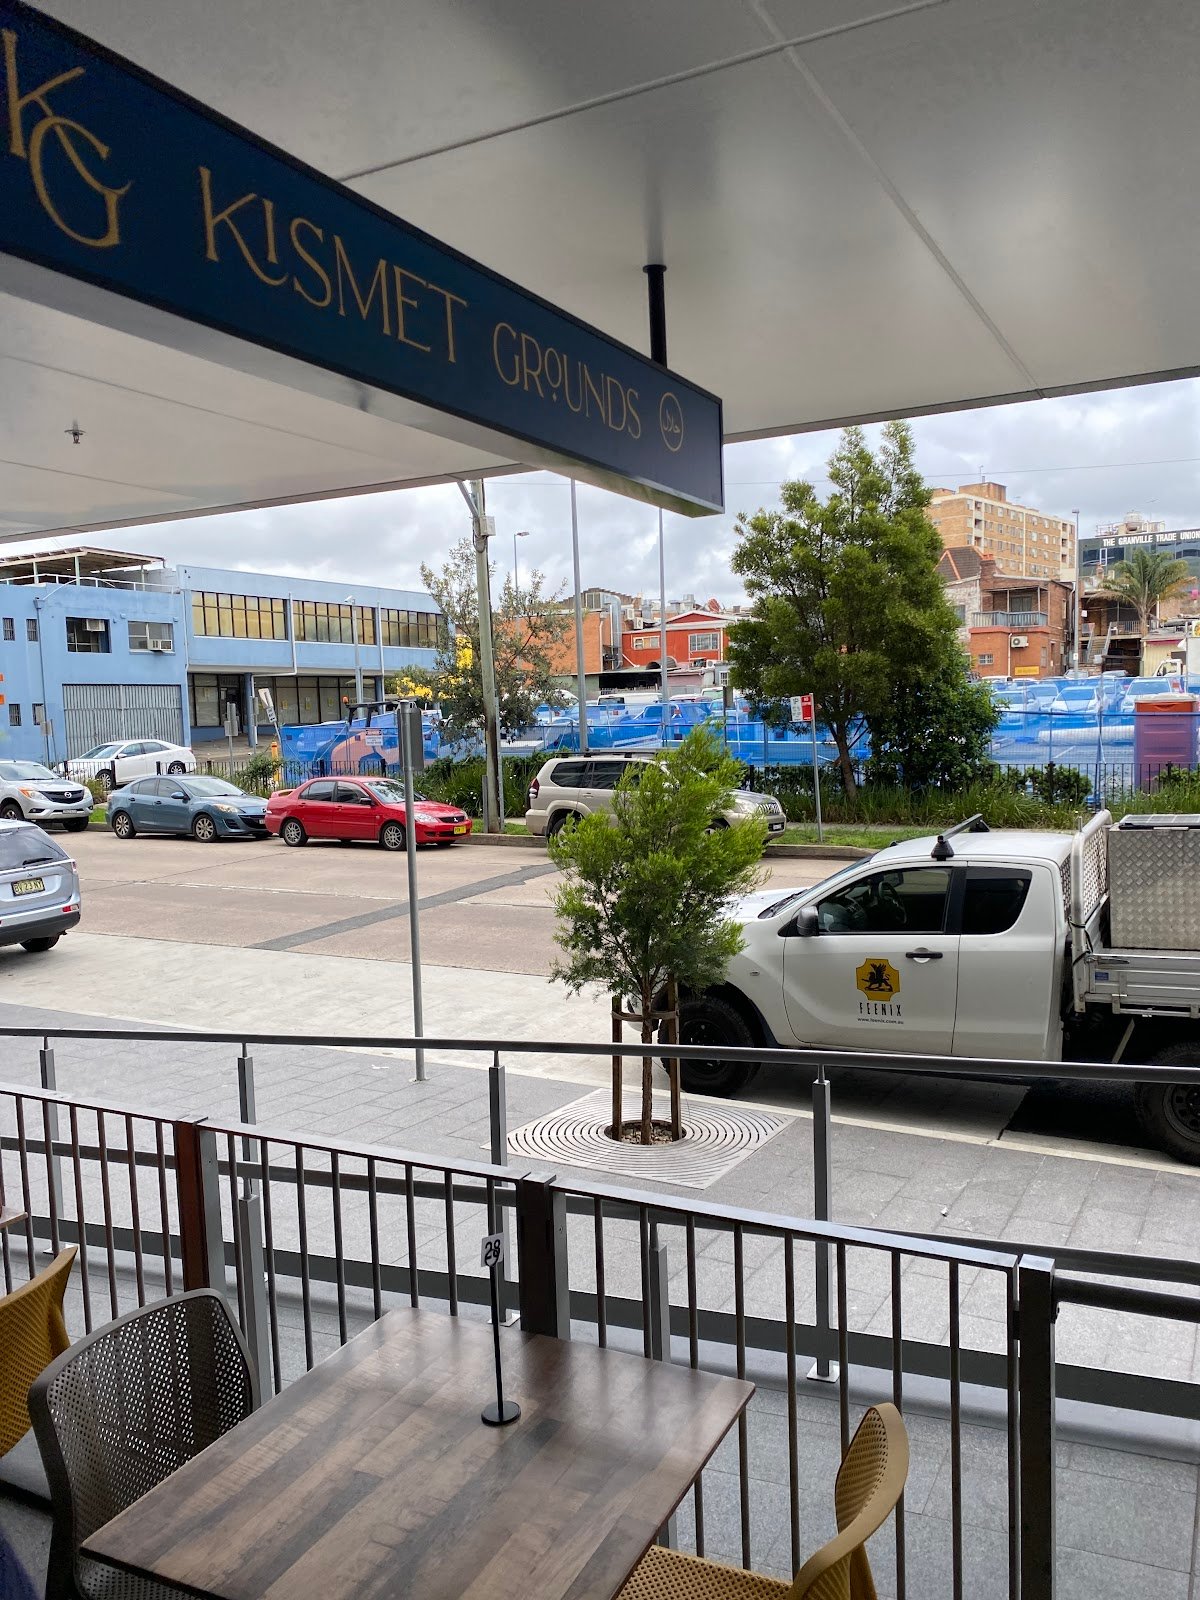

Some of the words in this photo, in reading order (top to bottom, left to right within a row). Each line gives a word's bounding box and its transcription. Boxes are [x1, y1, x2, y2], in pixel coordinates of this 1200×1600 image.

[199, 166, 468, 363] KISMET
[493, 322, 641, 439] GROUNDS
[1103, 538, 1115, 547] THE
[1118, 535, 1153, 545] GRANVILLE
[1156, 532, 1177, 542] TRADE
[1180, 530, 1200, 540] UNION
[859, 1002, 901, 1016] FEENIX
[857, 1017, 904, 1025] www.feenix.com.au
[485, 1239, 500, 1259] 28
